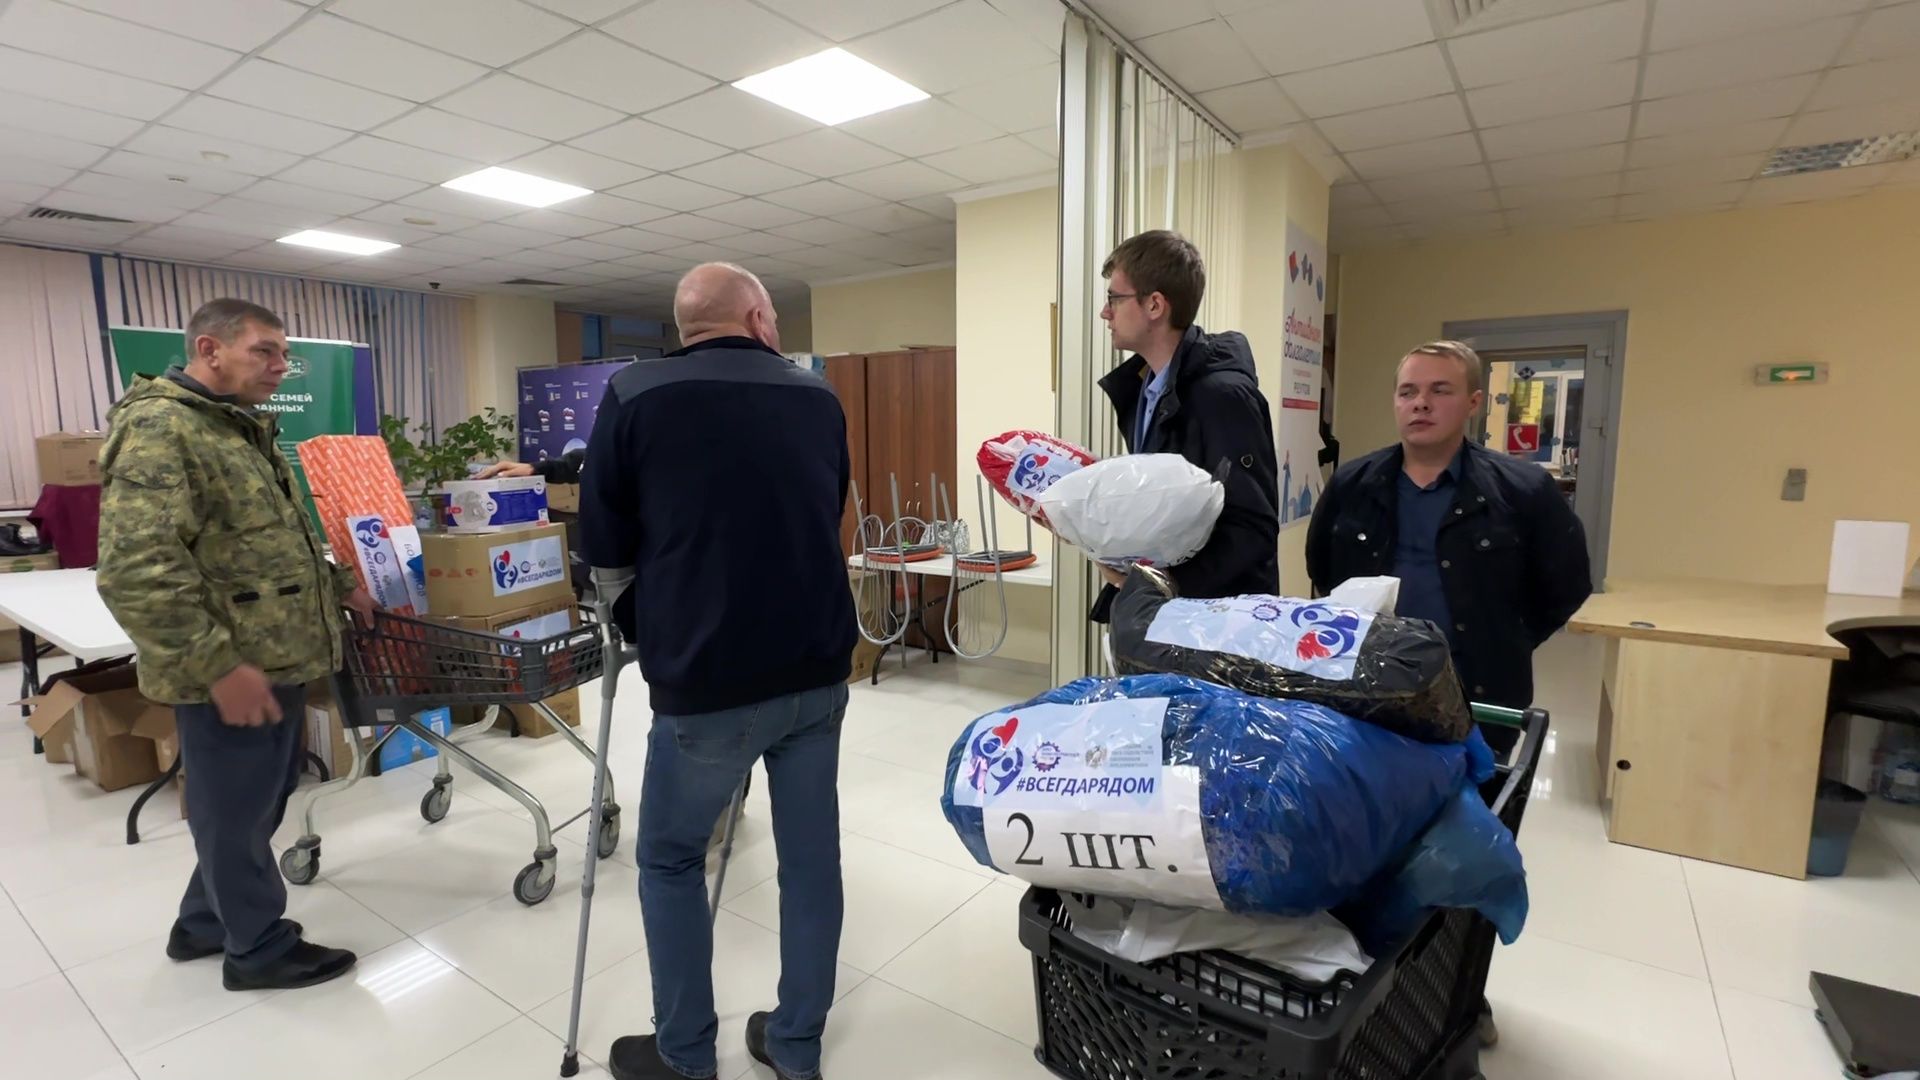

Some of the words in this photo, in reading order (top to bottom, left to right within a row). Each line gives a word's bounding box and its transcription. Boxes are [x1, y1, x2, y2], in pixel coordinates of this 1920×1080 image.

[269, 393, 313, 403] СЕМЕЙ
[517, 567, 562, 584] #ВСЕГДАРЯДОМ
[1016, 776, 1155, 797] #ВСЕГДАРЯДОМ
[1006, 812, 1044, 866] 2
